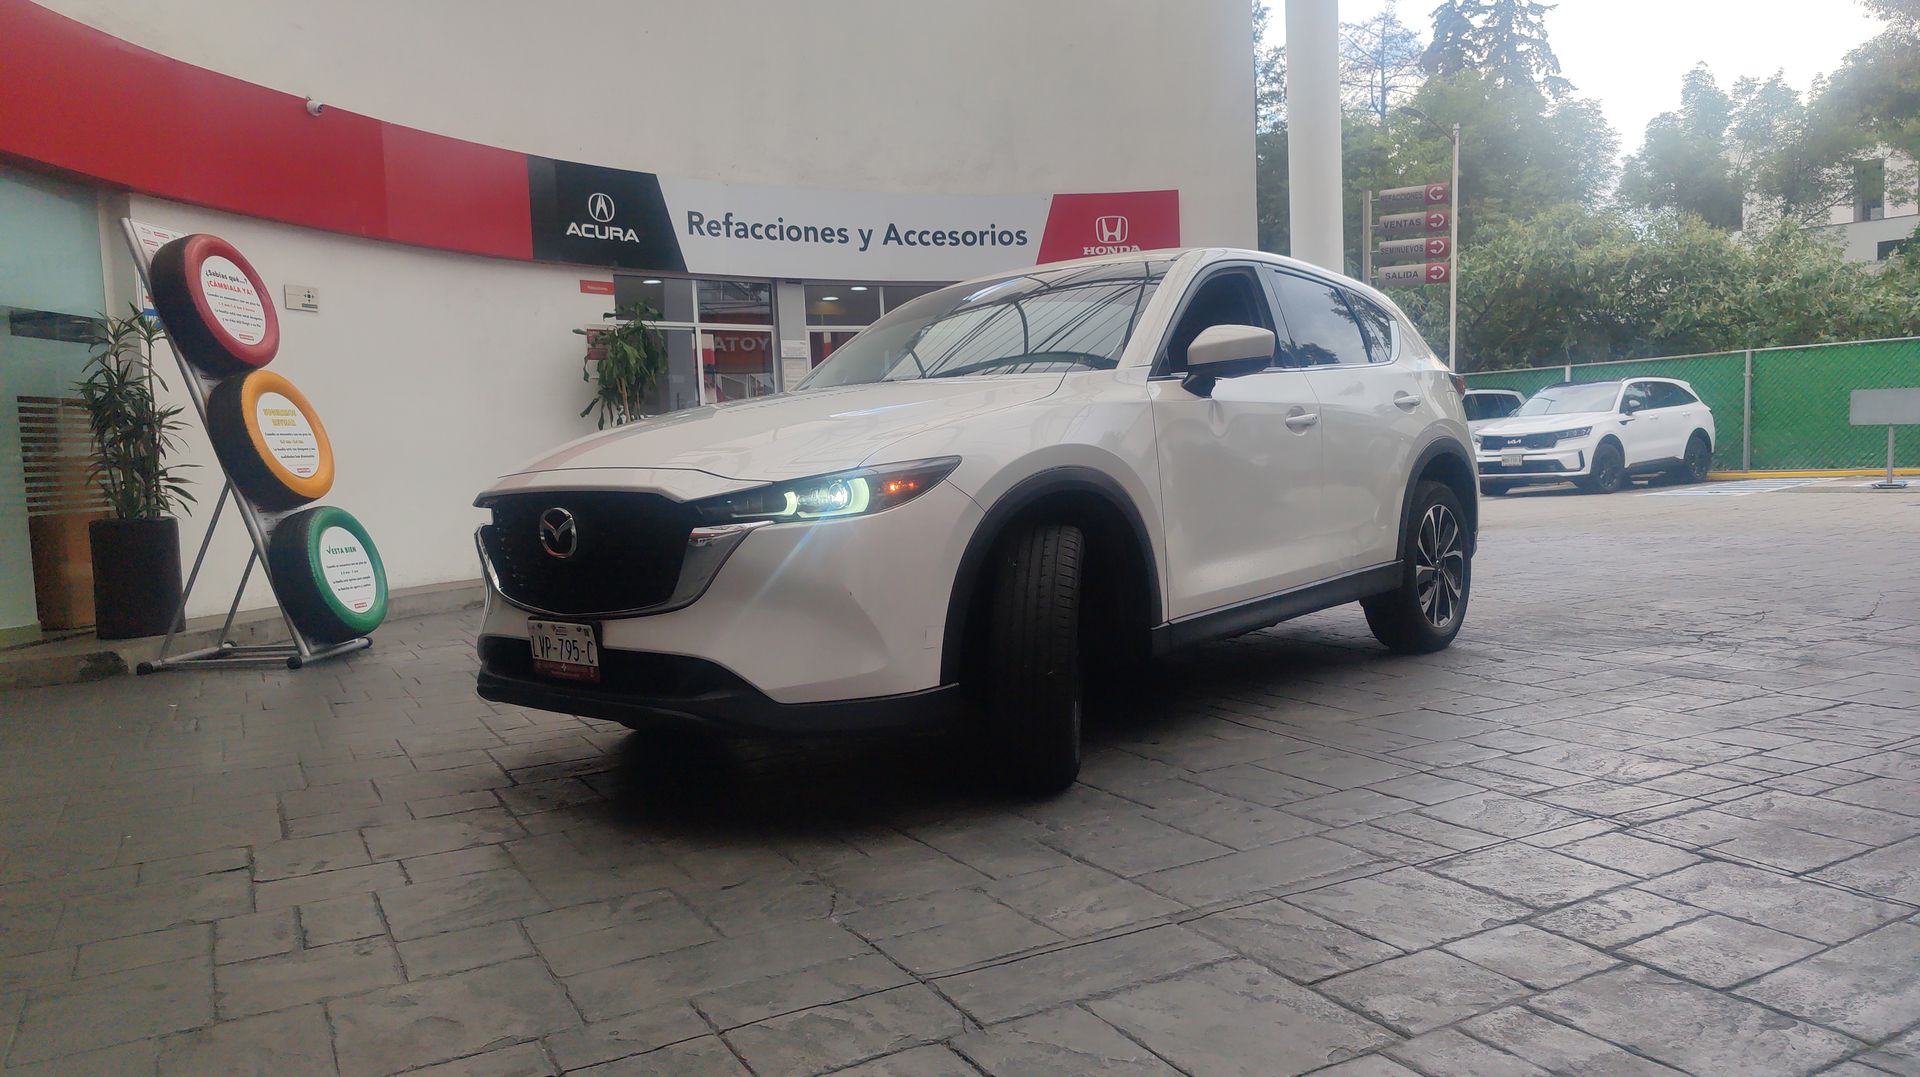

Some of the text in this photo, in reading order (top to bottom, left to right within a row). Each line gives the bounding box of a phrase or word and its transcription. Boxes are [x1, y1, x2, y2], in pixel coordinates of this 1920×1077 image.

[687, 210, 1029, 252] Refacciones y Accesorios
[1383, 218, 1422, 229] VENTAS
[566, 222, 640, 243] ACURA
[1083, 245, 1141, 256] HONDA
[1385, 271, 1419, 280] SALIDA
[531, 635, 594, 664] LVP-795-C
